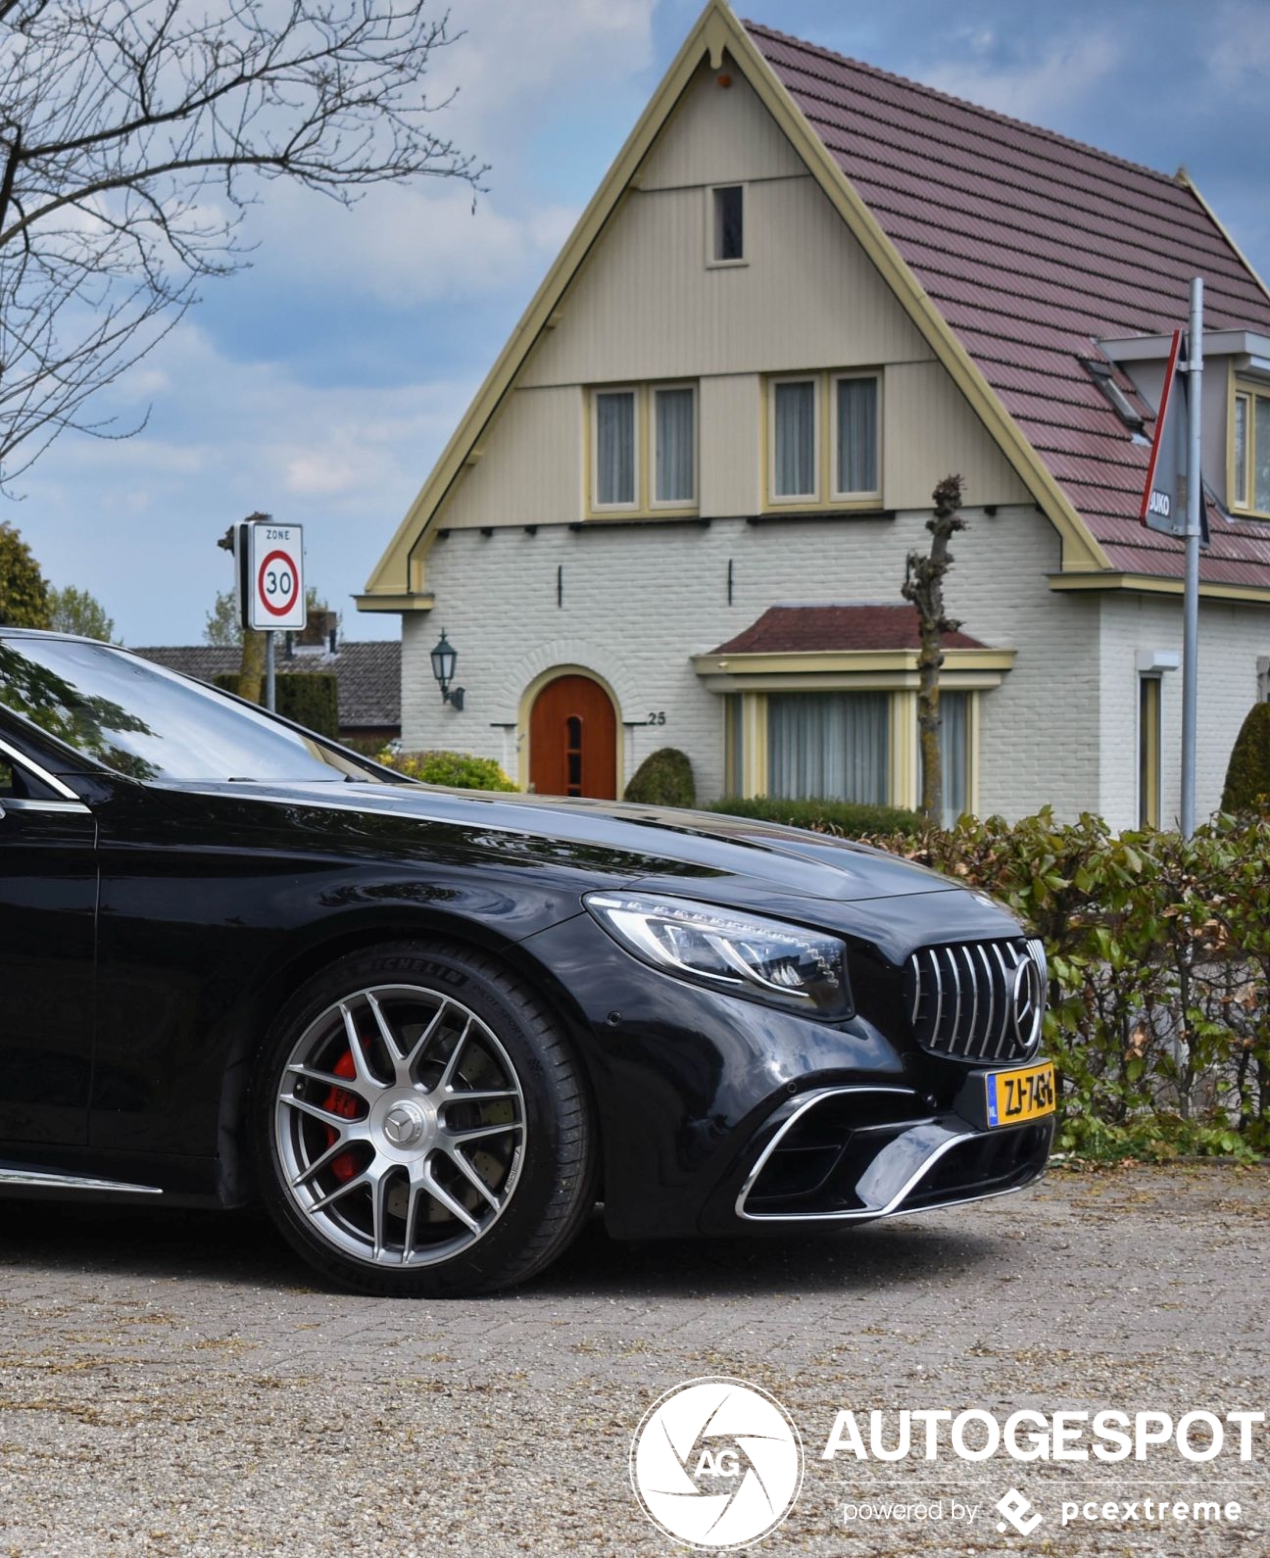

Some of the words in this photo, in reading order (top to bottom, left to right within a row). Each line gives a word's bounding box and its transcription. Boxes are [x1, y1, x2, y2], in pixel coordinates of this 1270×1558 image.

[266, 530, 291, 541] ZONE
[266, 572, 291, 595] 30
[648, 711, 666, 726] 25
